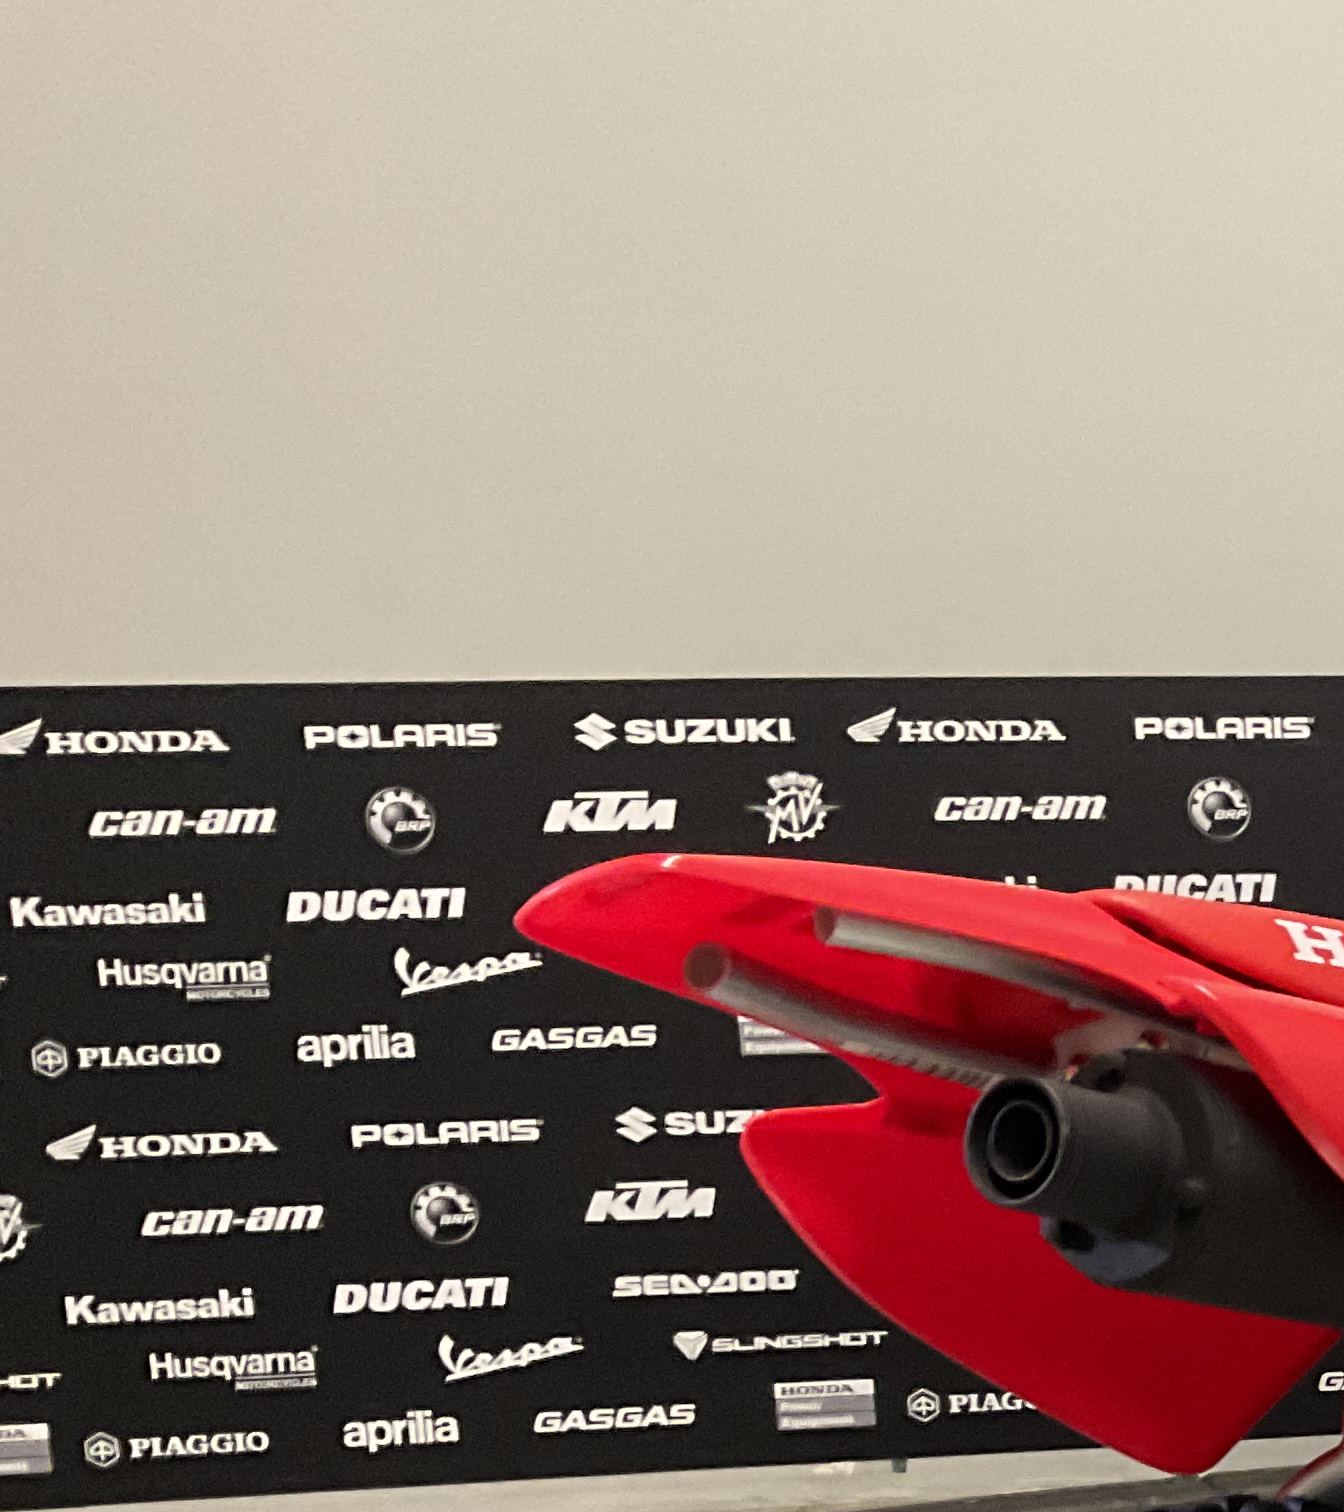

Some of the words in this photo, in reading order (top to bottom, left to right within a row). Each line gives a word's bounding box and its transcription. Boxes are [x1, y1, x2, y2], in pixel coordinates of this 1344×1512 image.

[43, 729, 231, 755] HONDA
[303, 722, 502, 750] POLARIS
[623, 717, 796, 745] SUZUKI
[897, 719, 1067, 743] HONDA
[1134, 716, 1315, 740] POLARIS
[88, 807, 277, 839] can-am
[542, 790, 678, 833] KTM
[933, 794, 1107, 822] can-am
[9, 891, 206, 928] Kawasaki
[285, 887, 467, 923] DUCATI
[97, 955, 272, 990] Husqvarna
[393, 947, 544, 997] Vespa
[297, 1023, 416, 1068] aprilia
[491, 1024, 657, 1052] GASGAS
[76, 1042, 222, 1069] PIAGGIO
[350, 1118, 544, 1148] POLARIS
[664, 1110, 764, 1138] SUZ
[97, 1131, 279, 1159] HONDA
[584, 1179, 716, 1223] KTM
[141, 1204, 324, 1237] can-am
[64, 1287, 255, 1325] Kawasaki
[333, 1276, 510, 1314] DUCATI
[711, 1330, 889, 1353] SLINGSHOT
[148, 1345, 320, 1382] Husqvarna
[438, 1334, 585, 1382] Vespa
[780, 1383, 854, 1397] HONDA
[944, 1388, 1040, 1413] PIAG
[342, 1409, 460, 1453] aprilia
[533, 1403, 696, 1434] GASGAS
[128, 1431, 270, 1459] PIAGGIO
